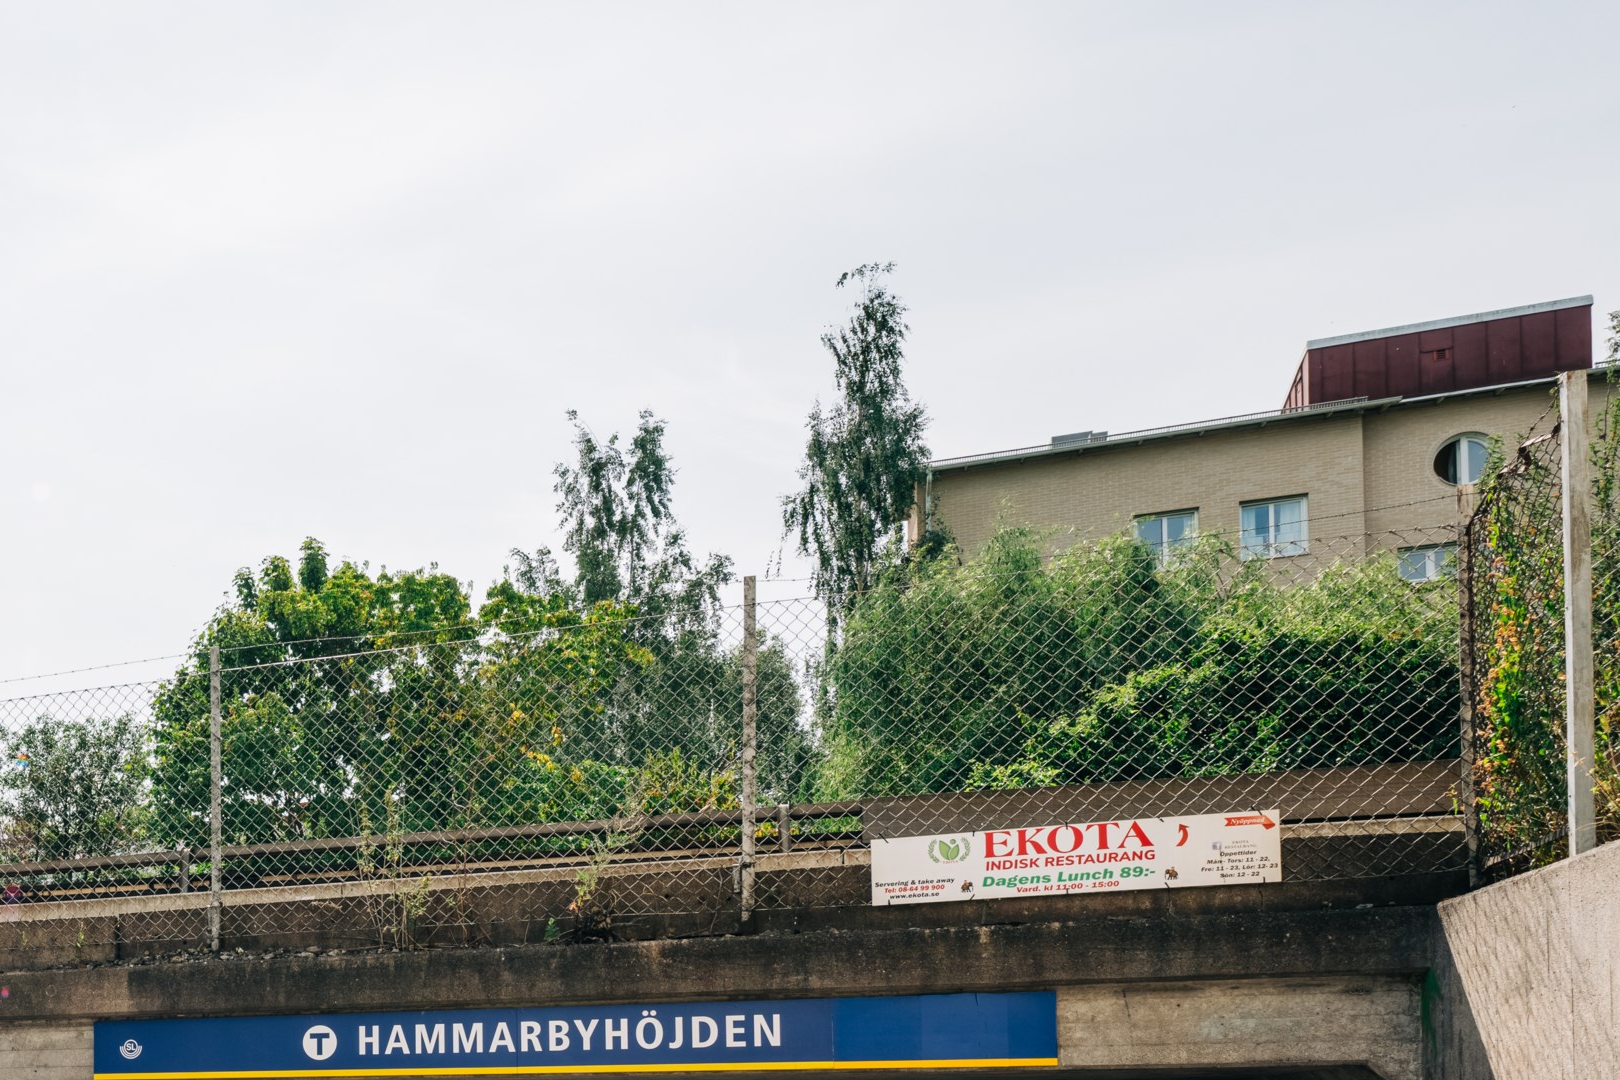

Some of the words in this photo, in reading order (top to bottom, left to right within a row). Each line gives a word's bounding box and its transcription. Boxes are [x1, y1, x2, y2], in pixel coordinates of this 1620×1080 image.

[983, 820, 1155, 859] EKOTA
[986, 857, 1040, 872] INDISK
[1044, 849, 1156, 867] RESTAURANG
[875, 880, 909, 888] Servering
[982, 872, 1051, 889] Dagens
[1057, 868, 1113, 883] Lunch
[1119, 866, 1156, 879] 89:-
[1016, 885, 1041, 893] Vard.
[1056, 882, 1083, 891] 11:00
[1091, 880, 1120, 888] 15:00
[889, 891, 940, 899] www.ekota.se
[898, 885, 918, 893] 08-64
[358, 1010, 782, 1056] HAMMARBYHÖJDEN
